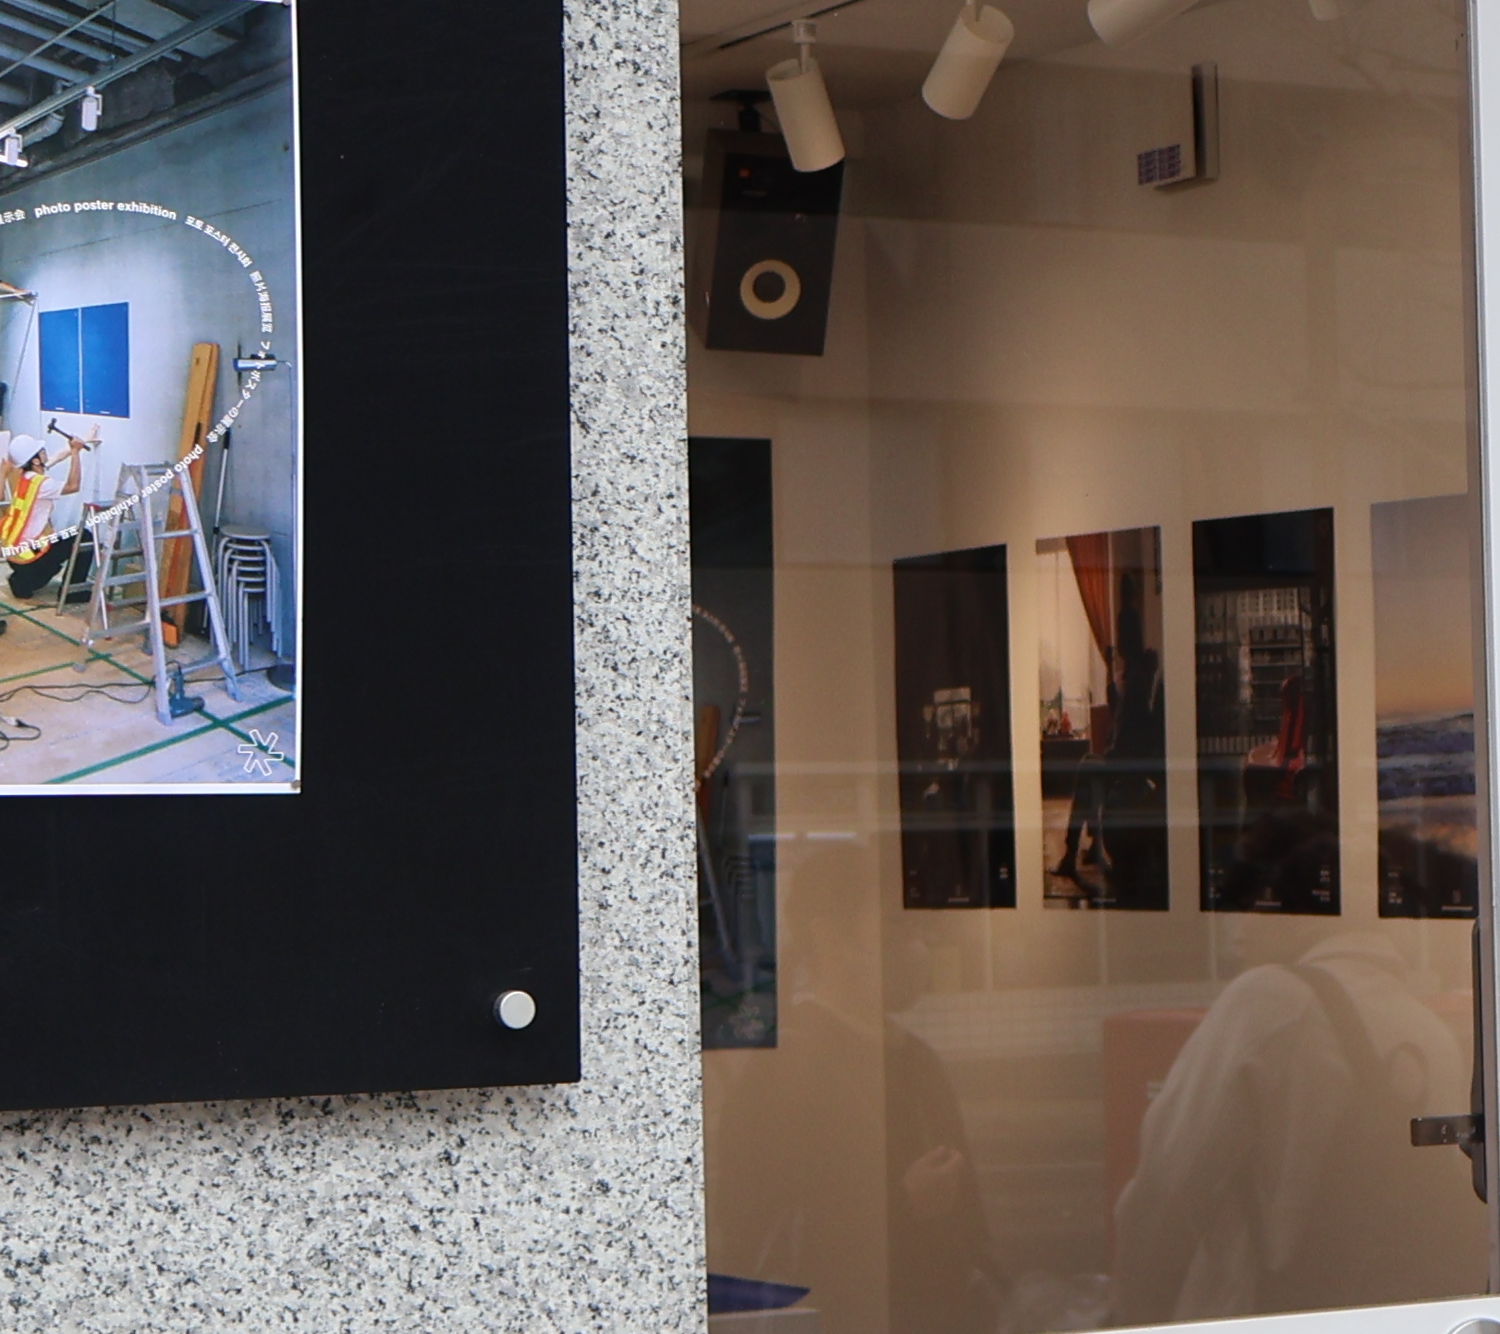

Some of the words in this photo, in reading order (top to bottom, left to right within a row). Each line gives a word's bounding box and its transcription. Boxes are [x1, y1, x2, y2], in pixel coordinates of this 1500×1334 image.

[34, 202, 71, 219] photo
[74, 200, 114, 213] poster
[117, 201, 177, 220] exhibition
[174, 443, 204, 473] photo
[141, 469, 174, 499] poster
[85, 495, 139, 527] exhibition
